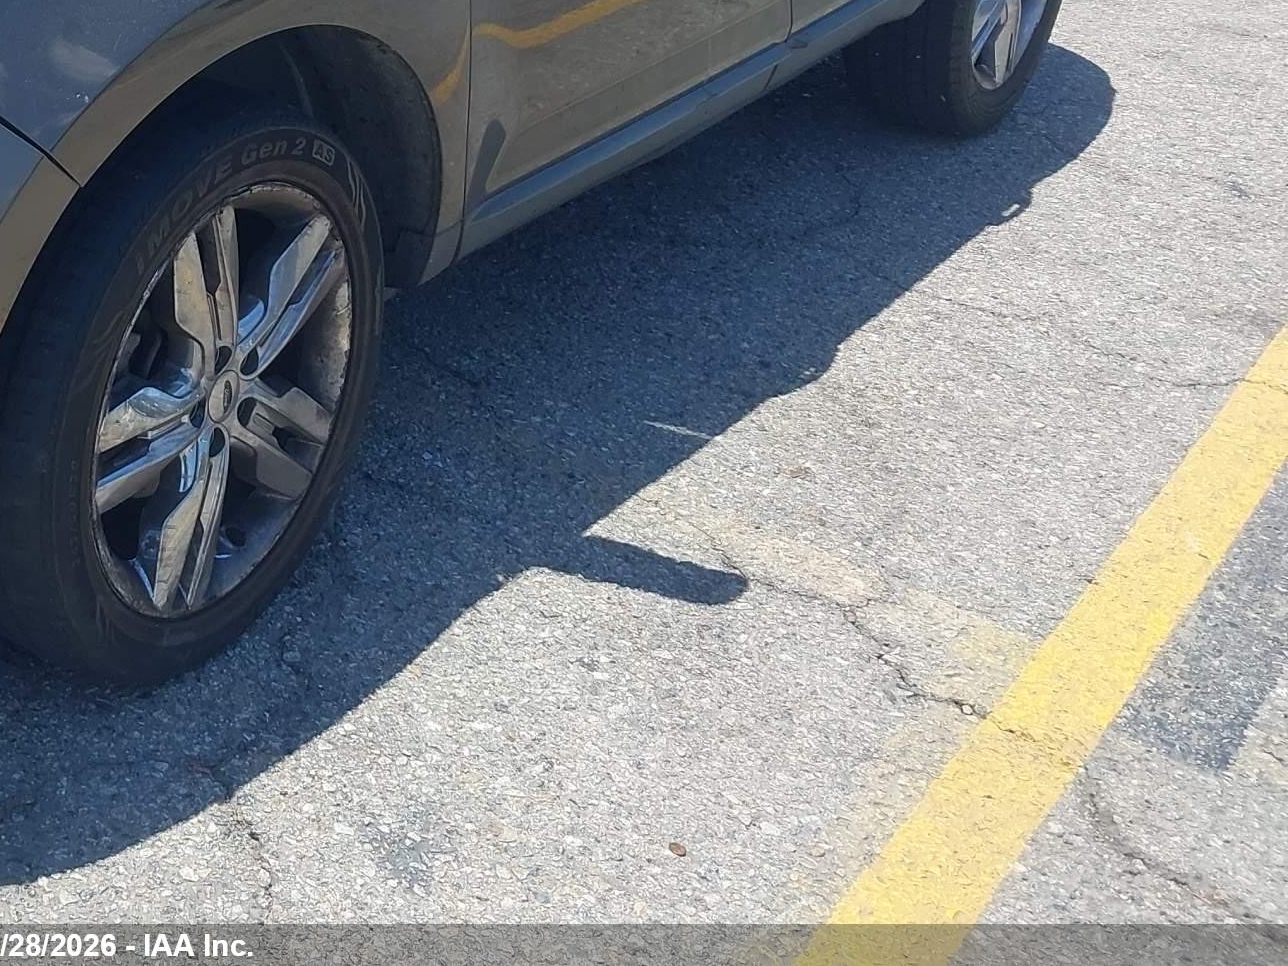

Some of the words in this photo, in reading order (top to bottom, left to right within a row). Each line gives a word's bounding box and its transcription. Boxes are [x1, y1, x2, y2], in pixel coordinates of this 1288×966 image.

[241, 139, 288, 165] Gen
[291, 137, 308, 156] 2
[313, 140, 335, 166] AS
